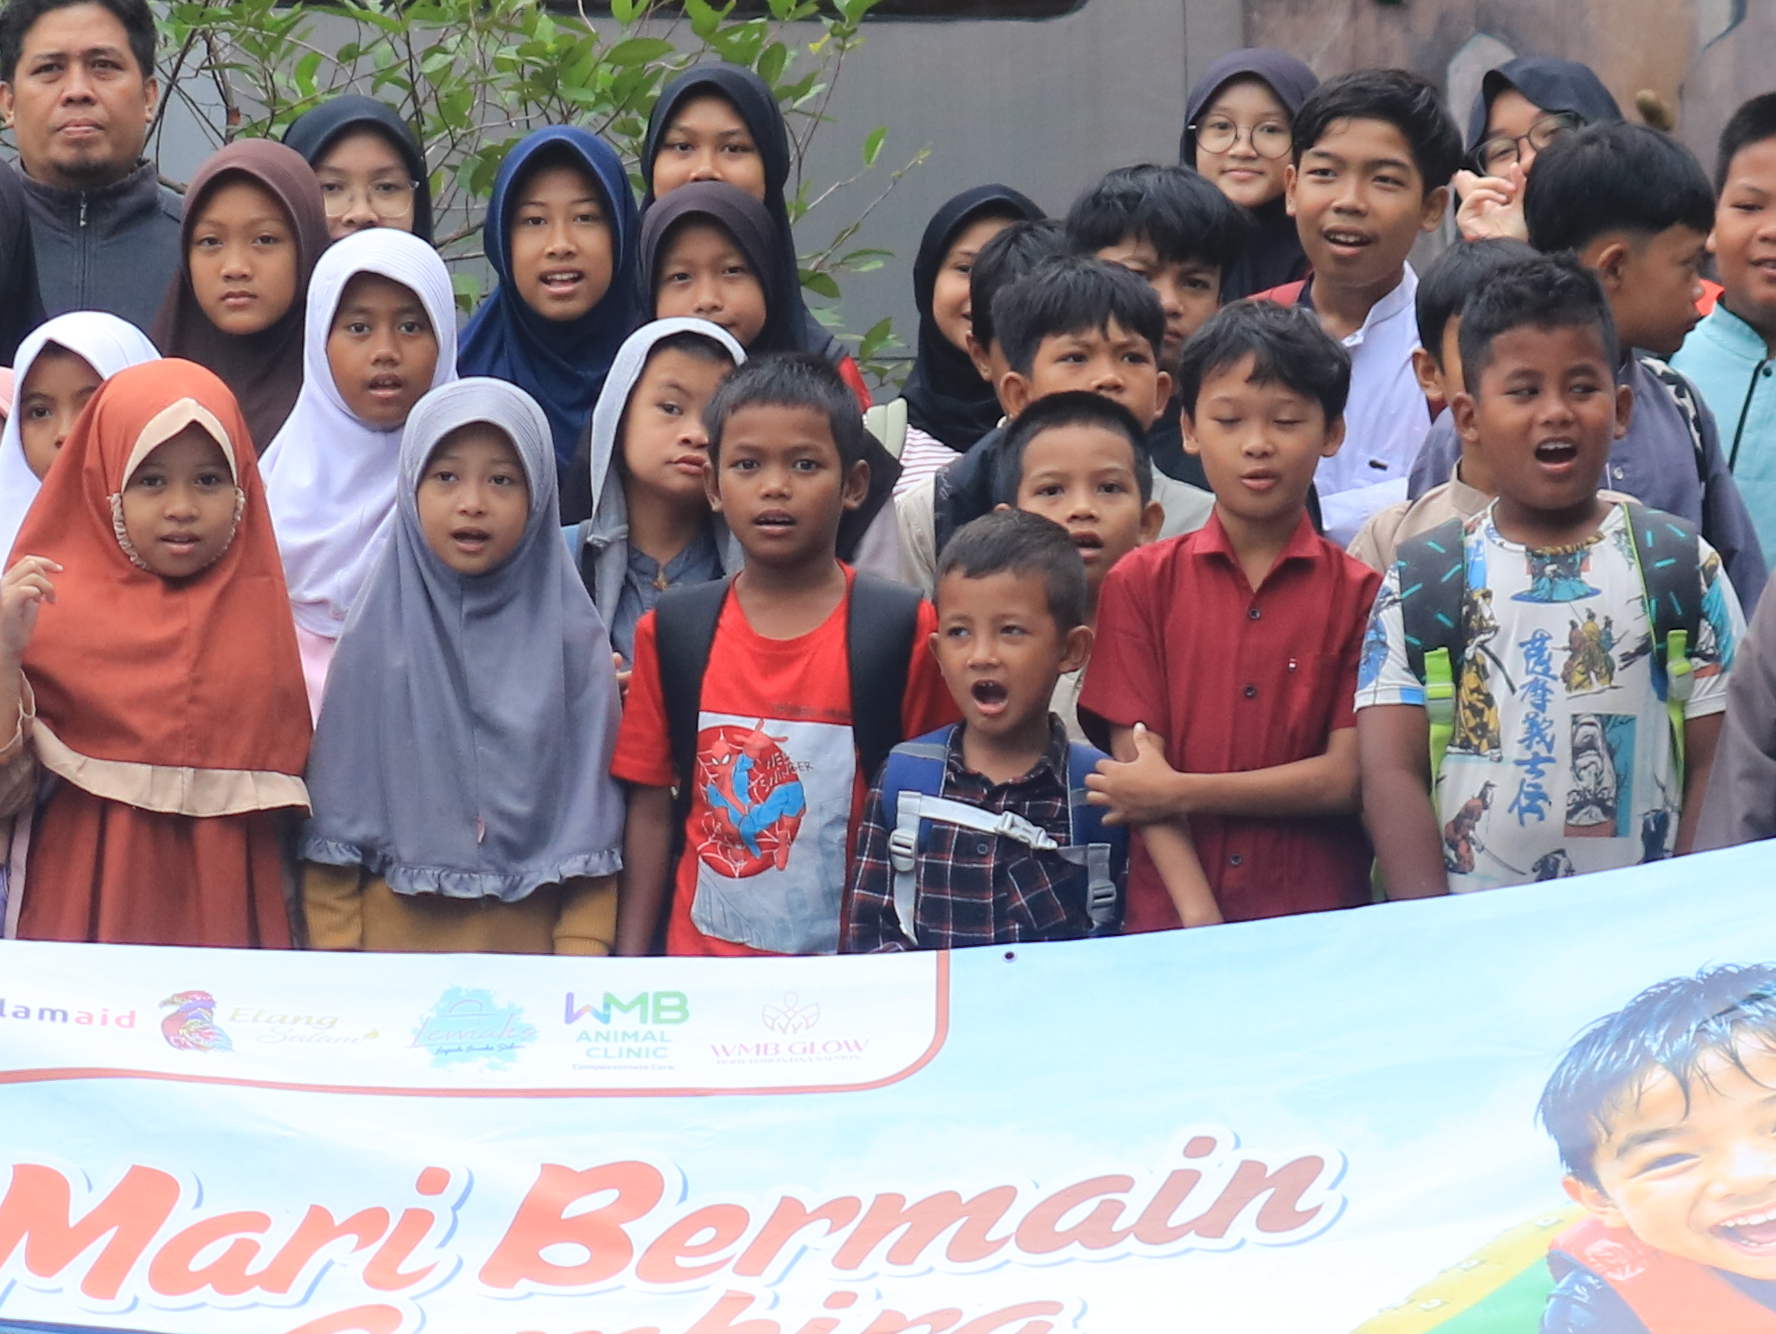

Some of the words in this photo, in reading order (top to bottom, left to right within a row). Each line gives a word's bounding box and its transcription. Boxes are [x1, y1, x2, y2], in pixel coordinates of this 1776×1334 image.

[564, 990, 690, 1025] WMB
[227, 1007, 340, 1031] Elang
[575, 1029, 673, 1044] ANIMAL
[710, 1042, 781, 1058] WMB
[788, 1037, 871, 1056] GLOW
[585, 1046, 669, 1060] CLINIC
[478, 1134, 1327, 1290] Bermain
